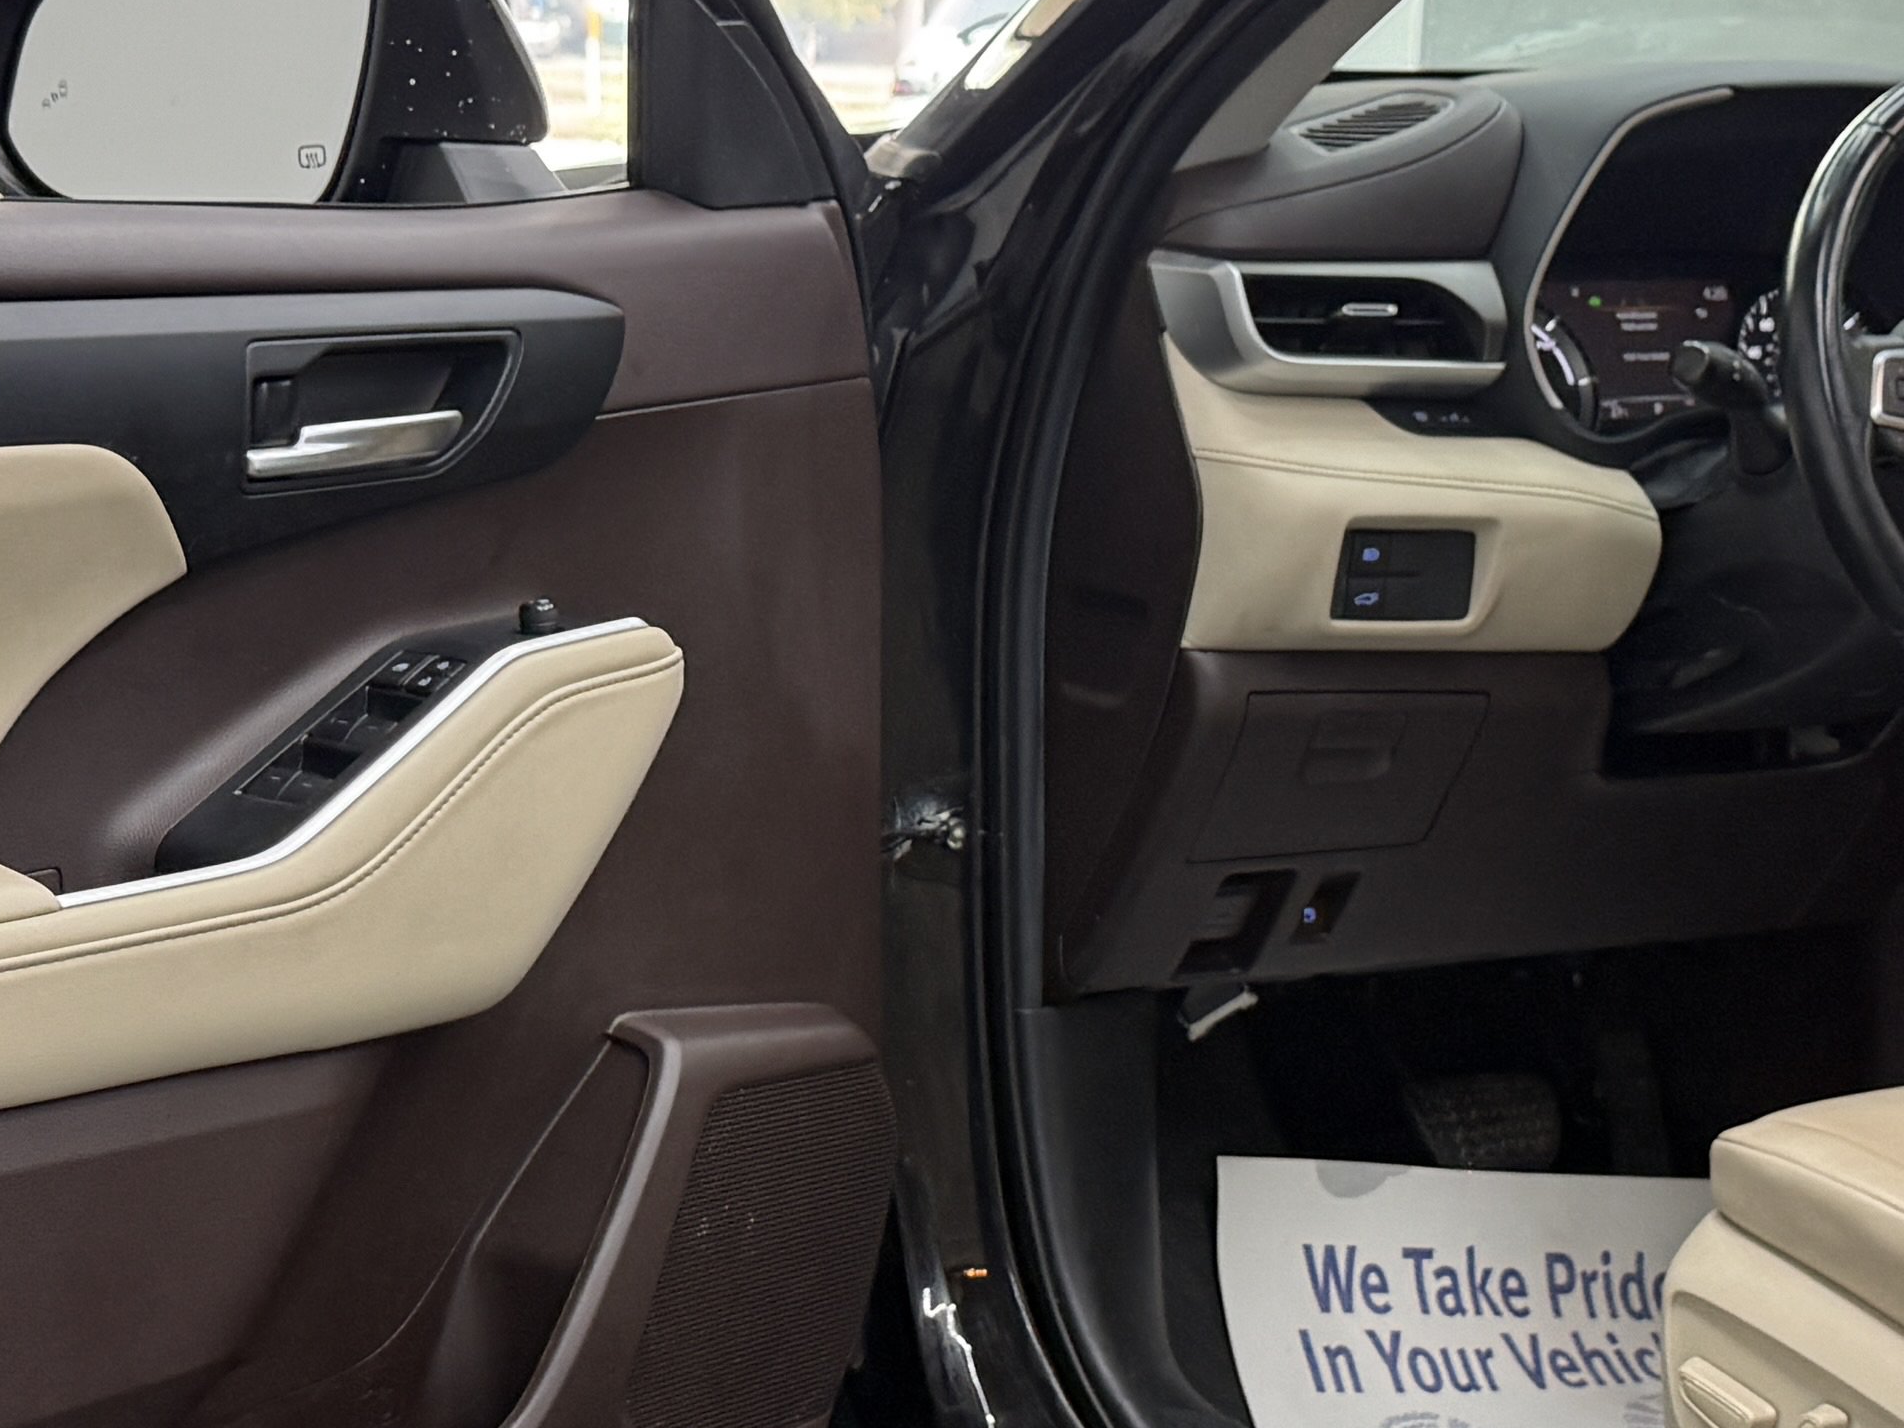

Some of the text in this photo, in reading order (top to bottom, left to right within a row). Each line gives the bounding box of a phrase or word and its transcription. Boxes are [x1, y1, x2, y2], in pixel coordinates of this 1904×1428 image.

[1303, 1243, 1393, 1314] We
[1402, 1245, 1531, 1318] Take
[1299, 1329, 1365, 1393] In
[1365, 1329, 1500, 1393] Your
